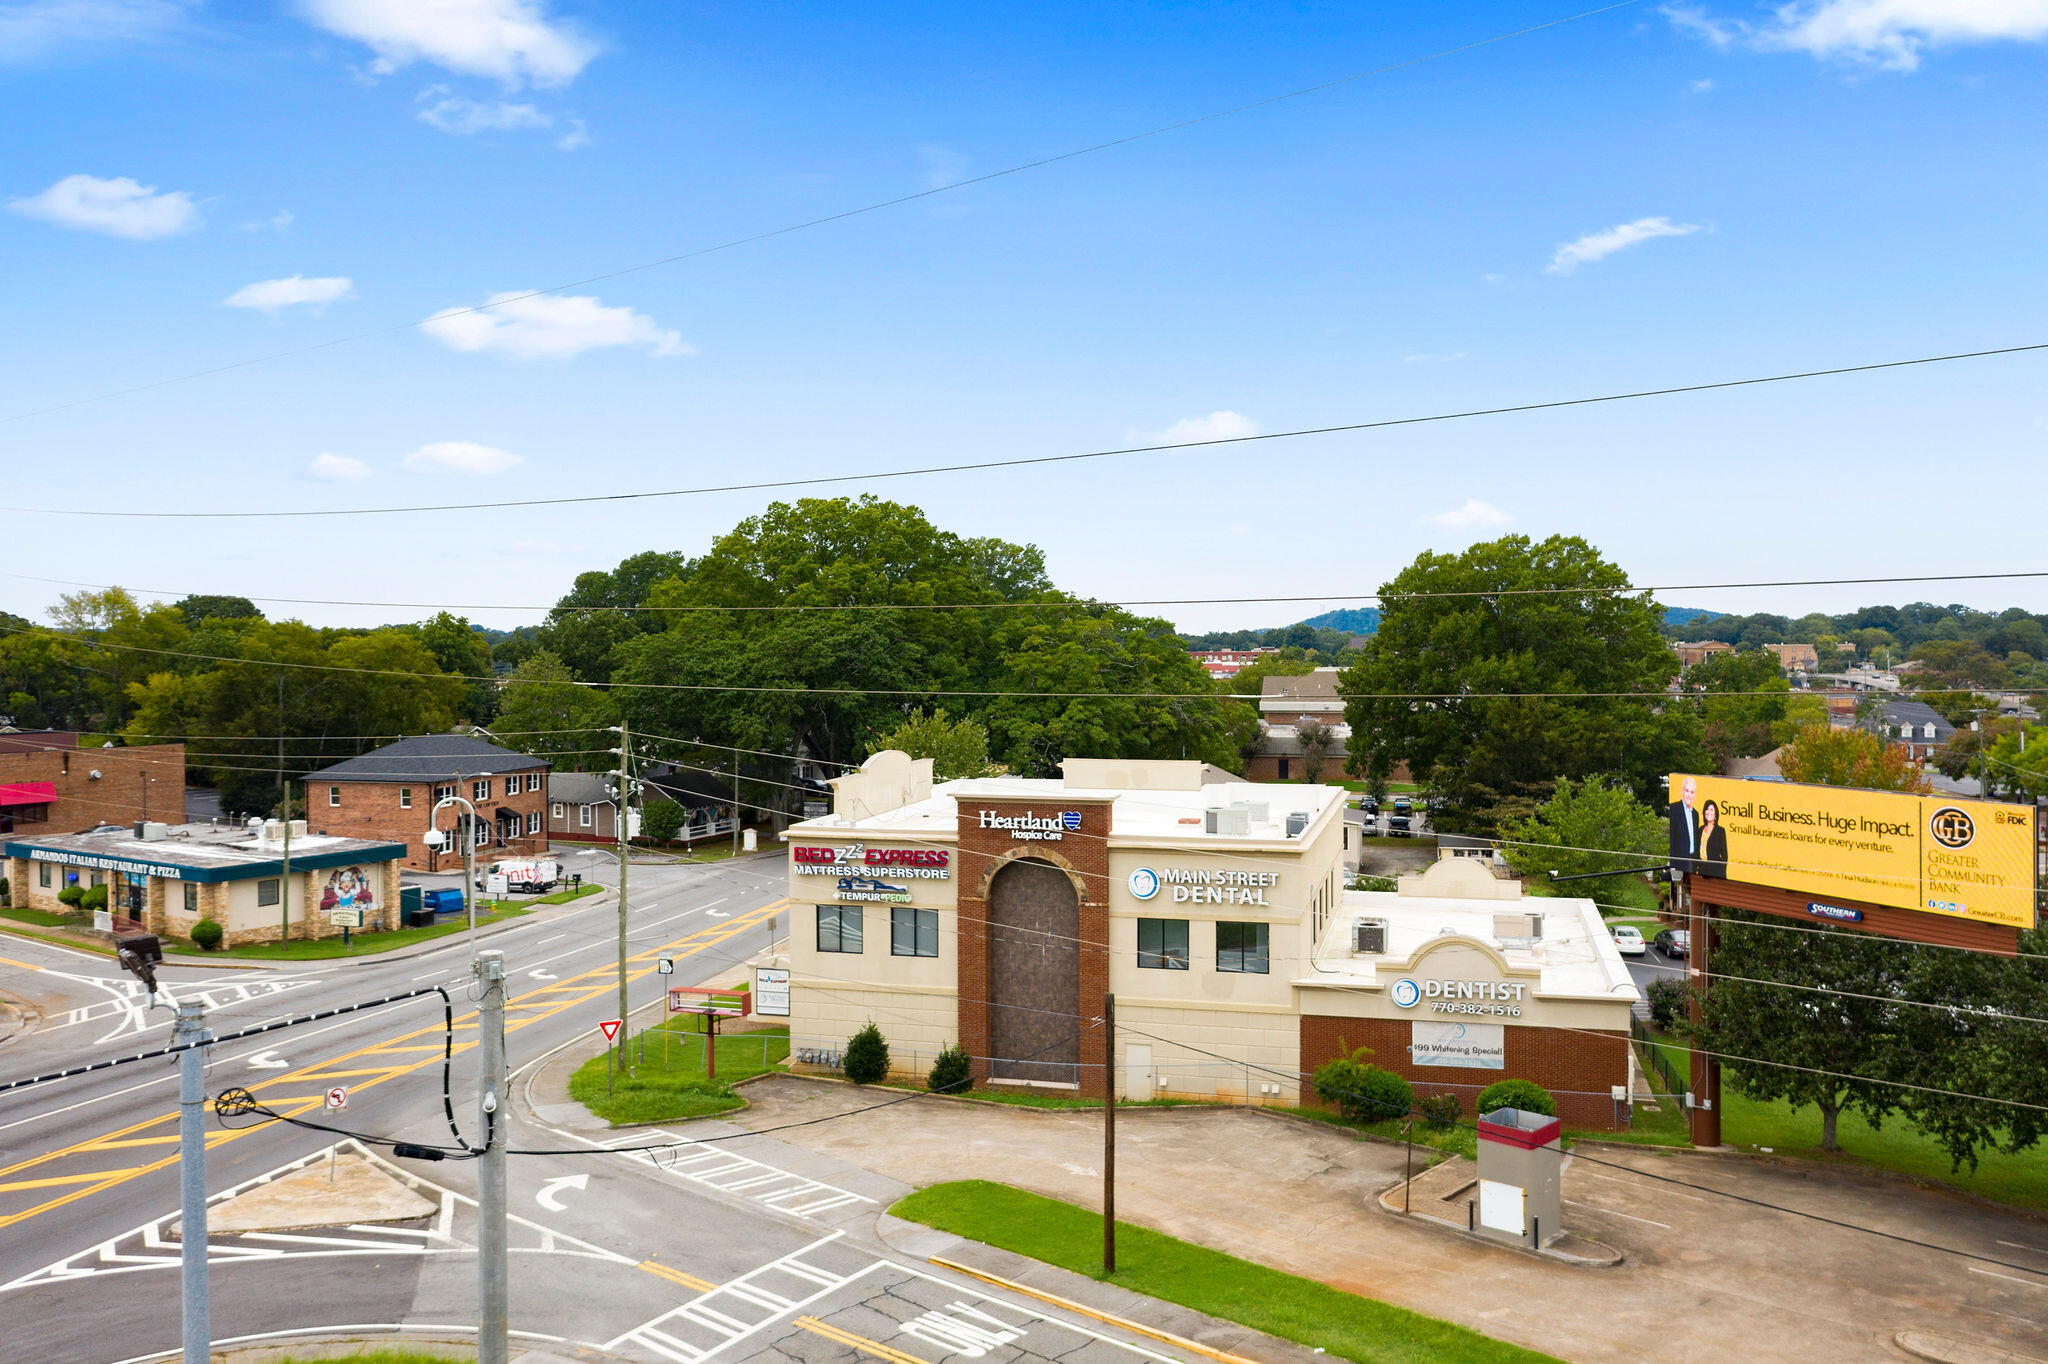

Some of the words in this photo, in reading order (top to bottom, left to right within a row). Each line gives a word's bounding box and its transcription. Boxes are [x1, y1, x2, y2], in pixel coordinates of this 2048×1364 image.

[978, 810, 1064, 831] Heartland
[1720, 800, 1754, 819] Small
[1758, 804, 1816, 826] Business.
[1818, 810, 1857, 834] Huge
[1860, 815, 1914, 839] Impact.
[1011, 829, 1042, 840] Hospice
[1044, 831, 1063, 840] Care
[1728, 822, 1752, 835] Small
[1753, 826, 1789, 840] business
[1790, 830, 1813, 843] loans
[1814, 833, 1827, 845] for
[1828, 838, 1854, 852] every
[68, 854, 98, 868] ITALIAN
[99, 858, 148, 875] RESTAURANT
[149, 865, 157, 876] &
[157, 866, 181, 879] PIZZA
[864, 849, 949, 868] EXPRESS
[1927, 849, 1979, 869] GREATER
[793, 865, 862, 878] MATTRESS
[863, 866, 949, 880] SUPERSTORE
[1163, 867, 1212, 885] MAIN
[1216, 869, 1280, 887] STREET
[1927, 863, 2006, 887] COMMUNITY
[1173, 885, 1270, 906] DENTAL
[1929, 878, 1961, 895] BANK
[1811, 903, 1856, 918] SOUTHERN
[1425, 979, 1526, 1001] DENTIST
[1431, 1002, 1521, 1017] 770-382-1516
[1414, 1044, 1429, 1052] $99
[1432, 1045, 1470, 1056] Whitening
[1472, 1046, 1503, 1056] Special!
[898, 1300, 1029, 1357] ONLY
